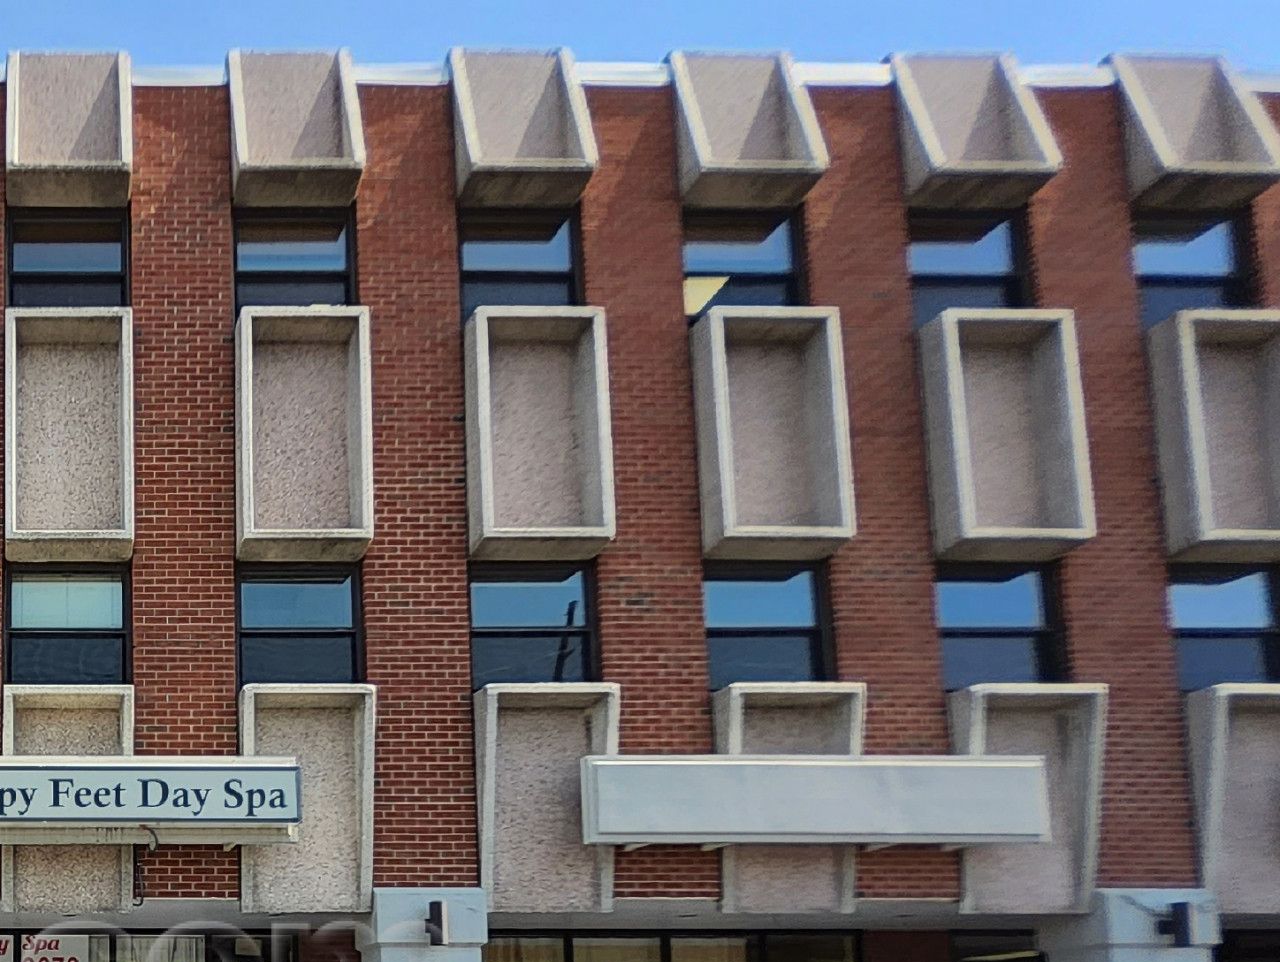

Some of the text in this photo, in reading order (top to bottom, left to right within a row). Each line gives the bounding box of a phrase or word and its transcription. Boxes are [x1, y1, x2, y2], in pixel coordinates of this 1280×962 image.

[48, 777, 126, 808] Feet
[137, 777, 212, 816] Day
[223, 778, 288, 817] Spa
[22, 935, 60, 955] Spa
